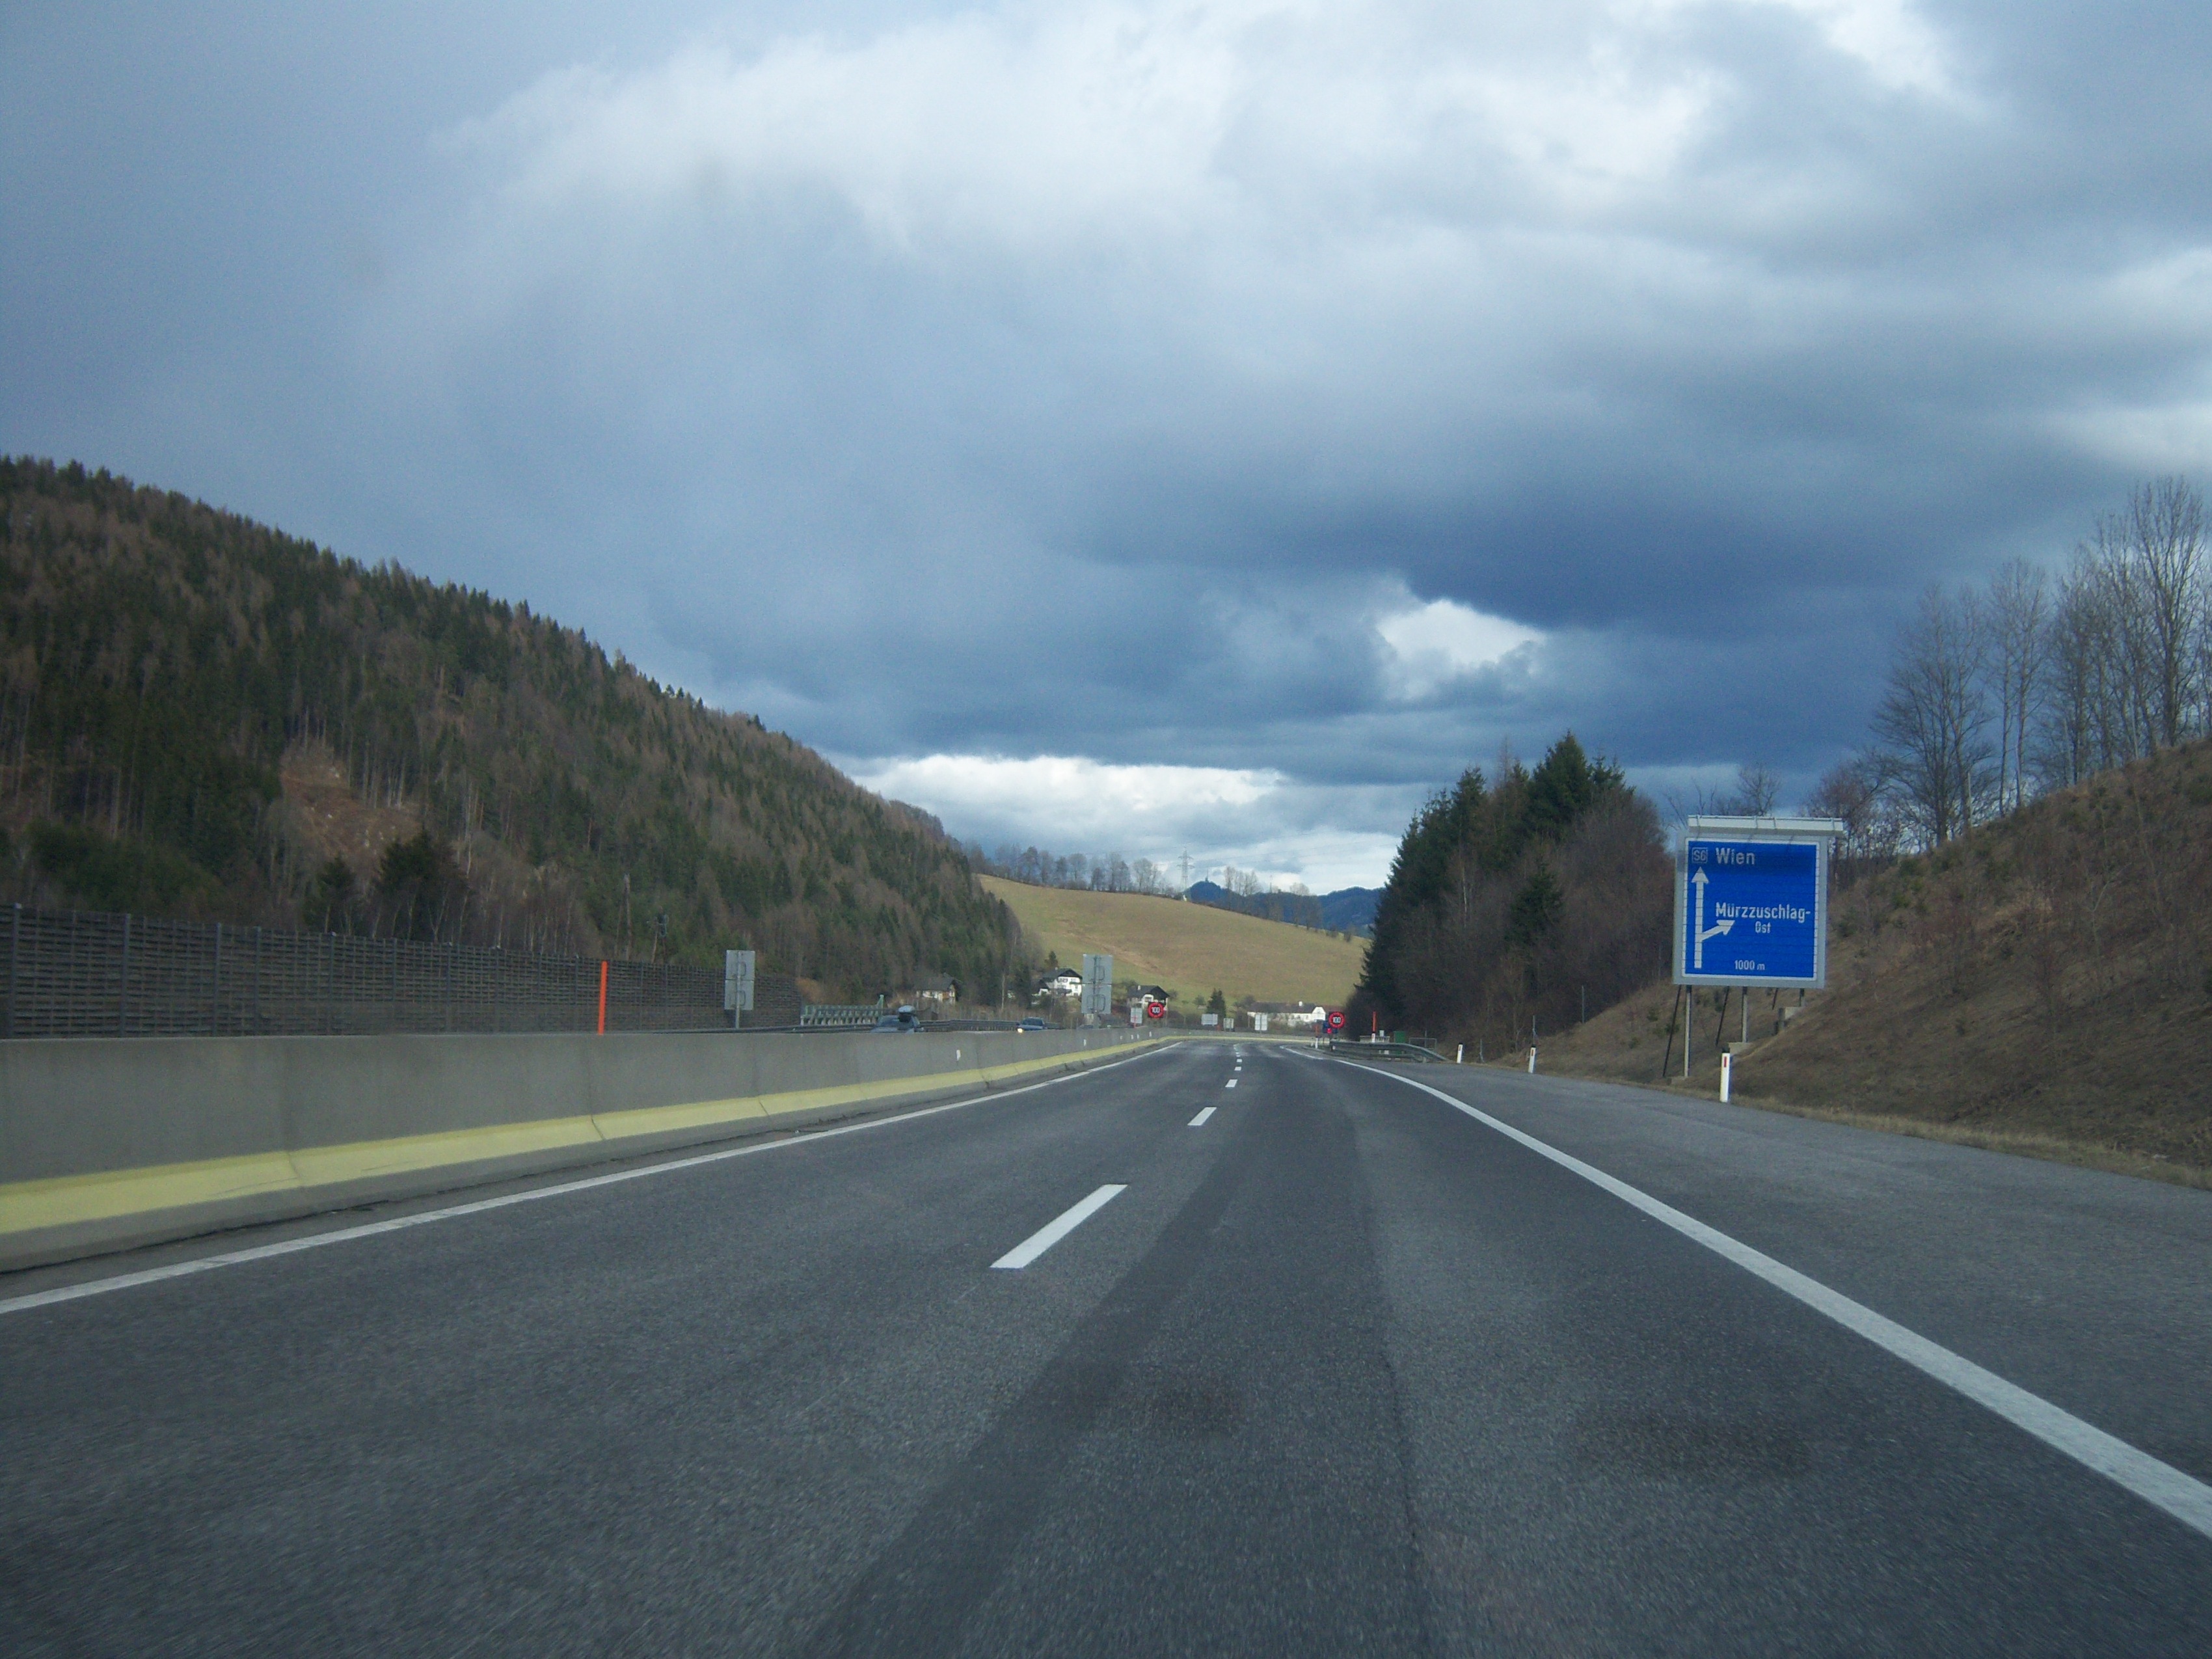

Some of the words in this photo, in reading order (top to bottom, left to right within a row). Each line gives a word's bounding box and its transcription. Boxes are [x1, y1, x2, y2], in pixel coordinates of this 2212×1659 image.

[1693, 849, 1706, 861] S6
[1716, 847, 1755, 865] Wien
[1716, 902, 1811, 923] Mürzzuschlag-
[1755, 921, 1771, 934] Ost
[1734, 960, 1755, 970] 1000
